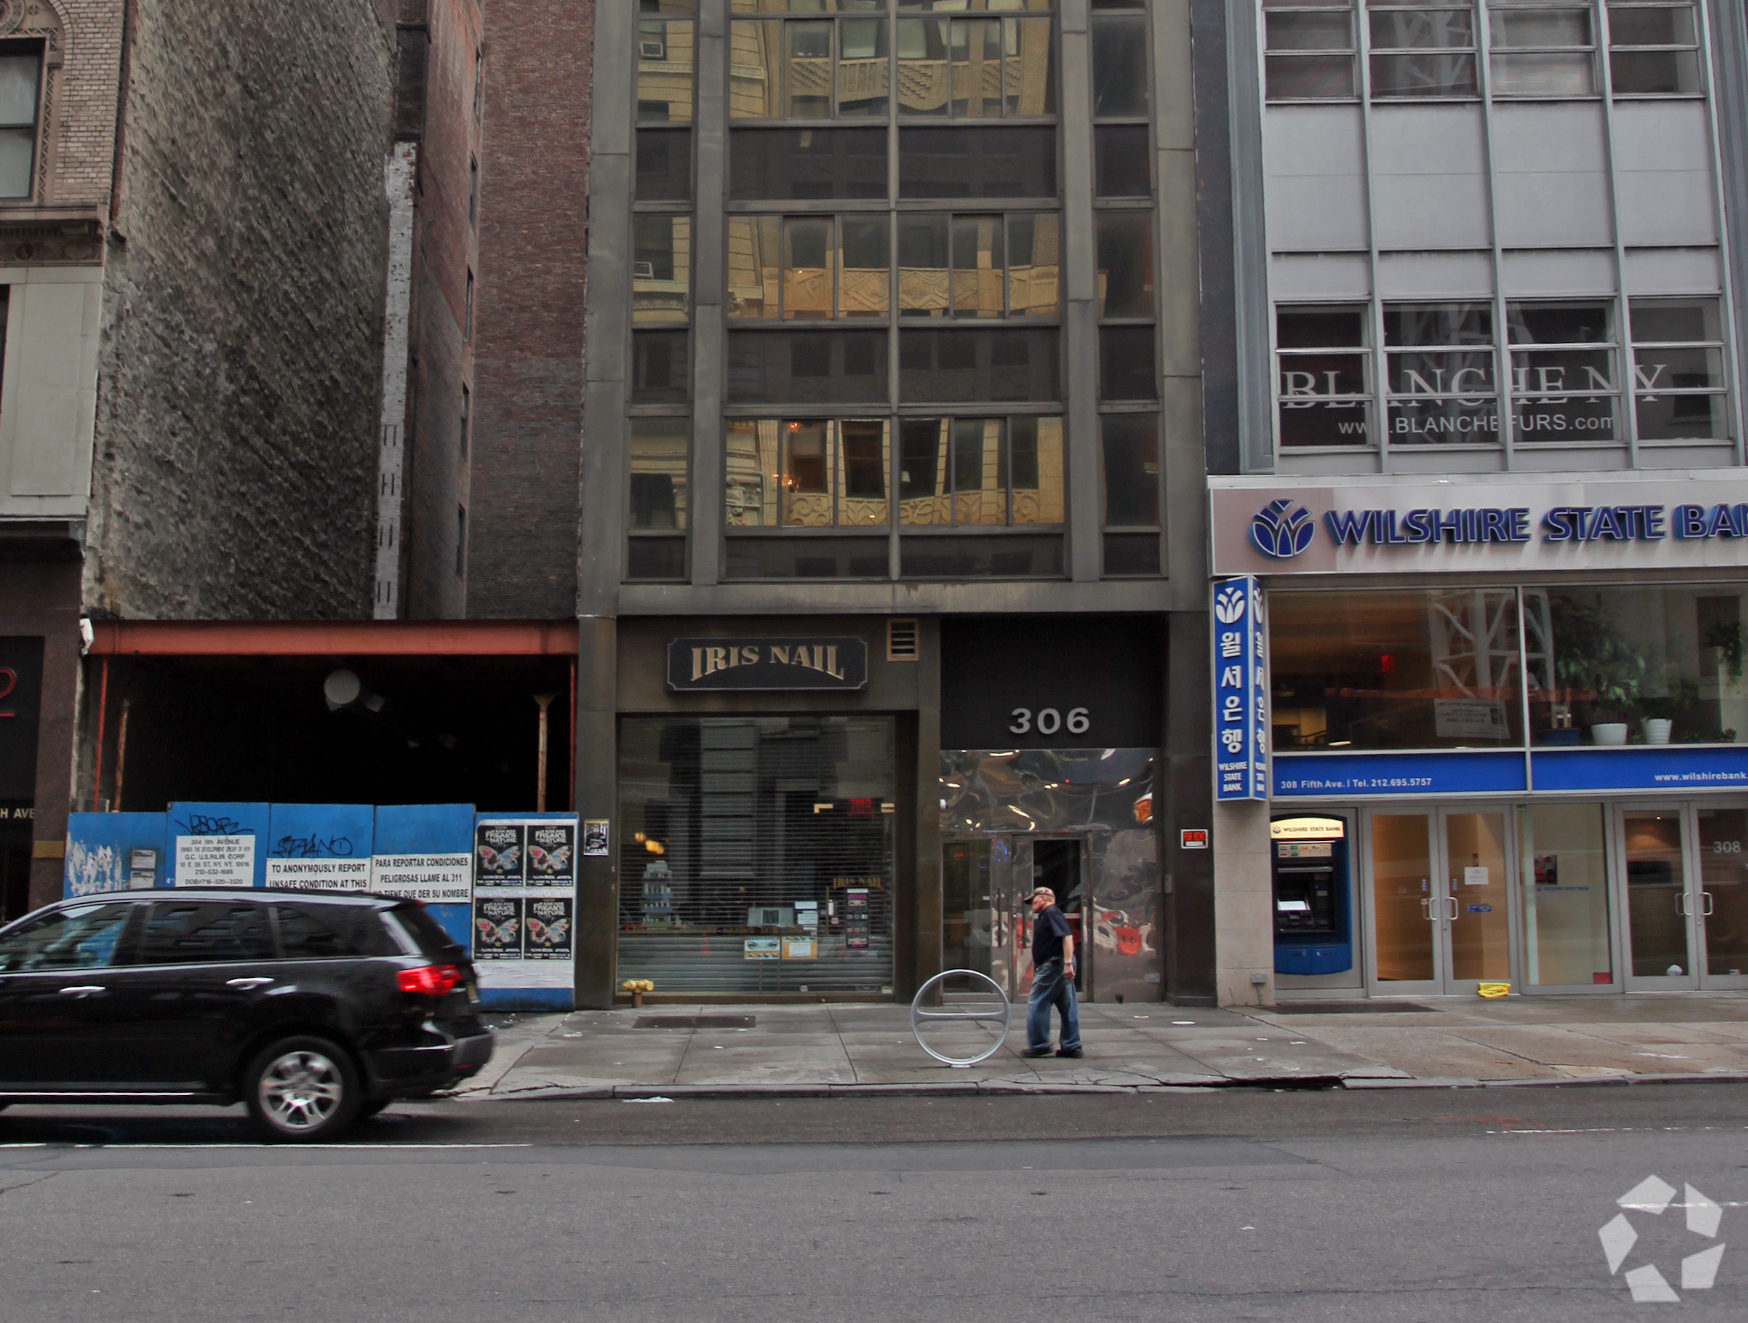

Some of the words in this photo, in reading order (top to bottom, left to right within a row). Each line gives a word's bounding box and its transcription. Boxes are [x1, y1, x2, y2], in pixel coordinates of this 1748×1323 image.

[1326, 507, 1531, 544] WILSHIRE
[1544, 504, 1667, 543] STATE
[691, 645, 760, 681] IRIS
[769, 645, 844, 681] NAIL
[1009, 707, 1090, 735] 306
[1218, 761, 1247, 771] WILSHIRE
[1224, 772, 1242, 781] STATE
[1223, 783, 1242, 792] BANK
[1280, 780, 1297, 789] 308
[1301, 780, 1323, 789] Fifth
[1325, 780, 1346, 788] Ave.
[1352, 779, 1369, 787] Tel.
[1371, 778, 1432, 787] 212.695.5757
[13, 808, 34, 818] AVE
[1713, 840, 1741, 854] 308
[375, 859, 391, 867] PARA
[393, 858, 425, 867] REPORTAR
[426, 857, 468, 866] CONDICIONES
[272, 864, 281, 873] TO
[283, 864, 336, 873] ANONYMOUSLY
[338, 863, 366, 872] REPORT
[380, 873, 418, 883] PELIGROSAS
[420, 873, 440, 882] LLAME
[442, 873, 449, 882] AL
[451, 873, 462, 882] 311
[269, 880, 297, 889] UNSAFE
[299, 879, 338, 889] CONDITION
[340, 879, 349, 888] AT
[351, 879, 367, 888] THIS
[403, 889, 416, 898] QUE
[418, 889, 431, 898] DER
[432, 889, 441, 898] SU
[442, 889, 468, 898] NOMBRE
